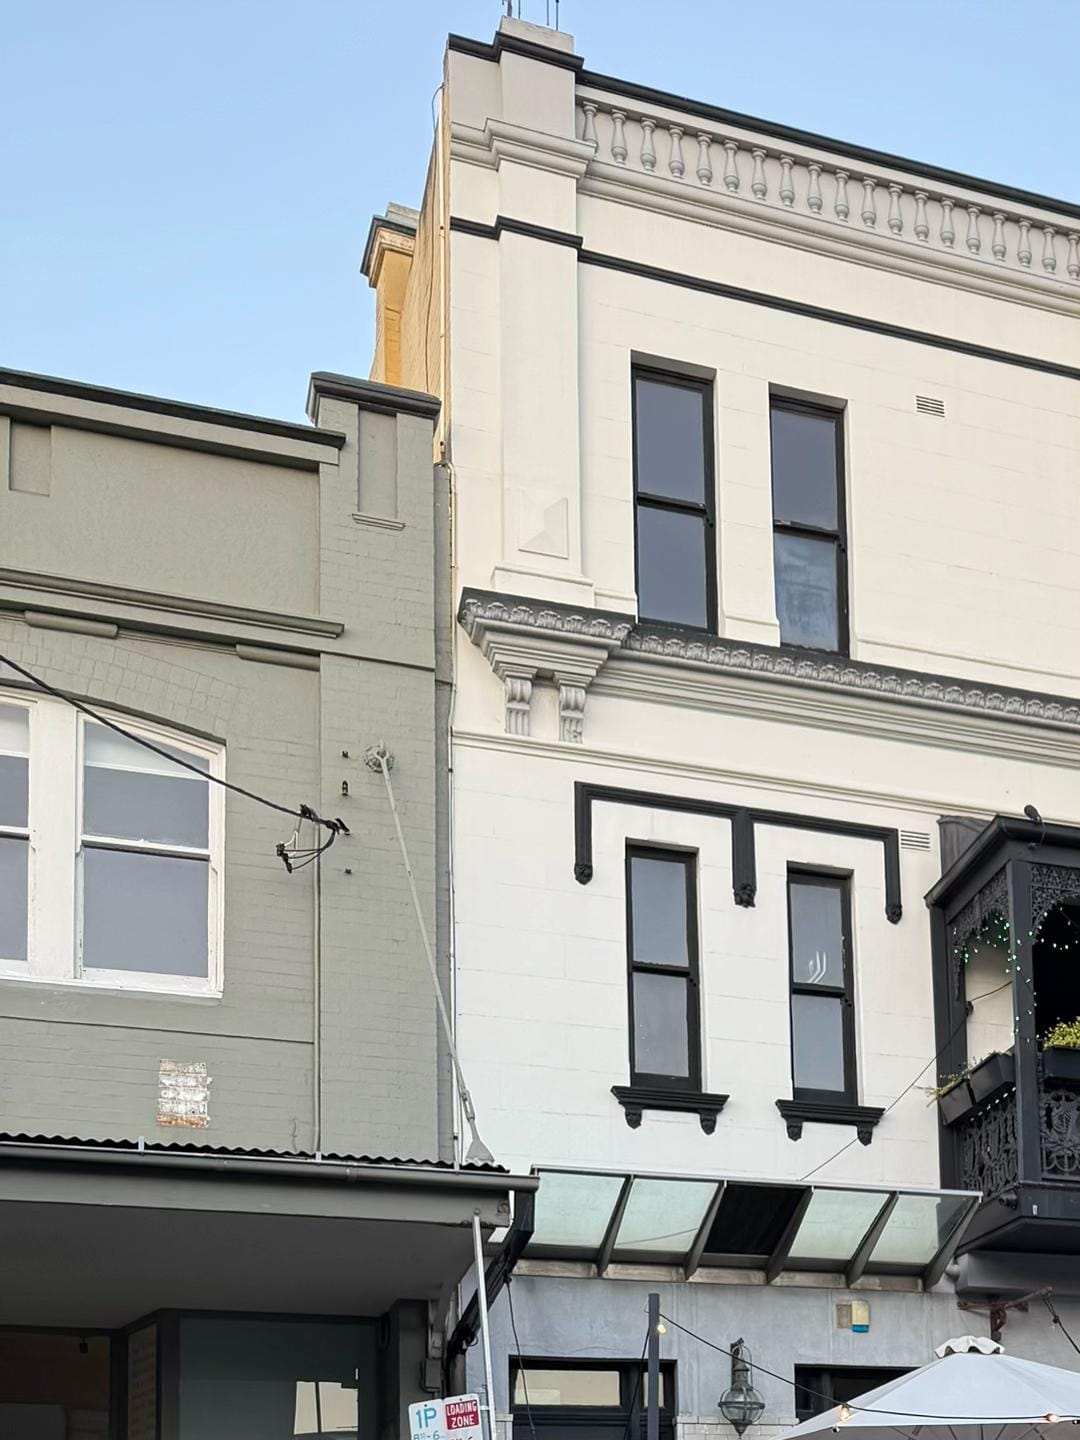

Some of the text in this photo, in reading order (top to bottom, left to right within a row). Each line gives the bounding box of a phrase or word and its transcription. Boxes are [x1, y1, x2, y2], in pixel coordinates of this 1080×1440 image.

[446, 1400, 478, 1416] LOADING
[415, 1407, 437, 1429] 1P
[451, 1414, 475, 1429] ZONE
